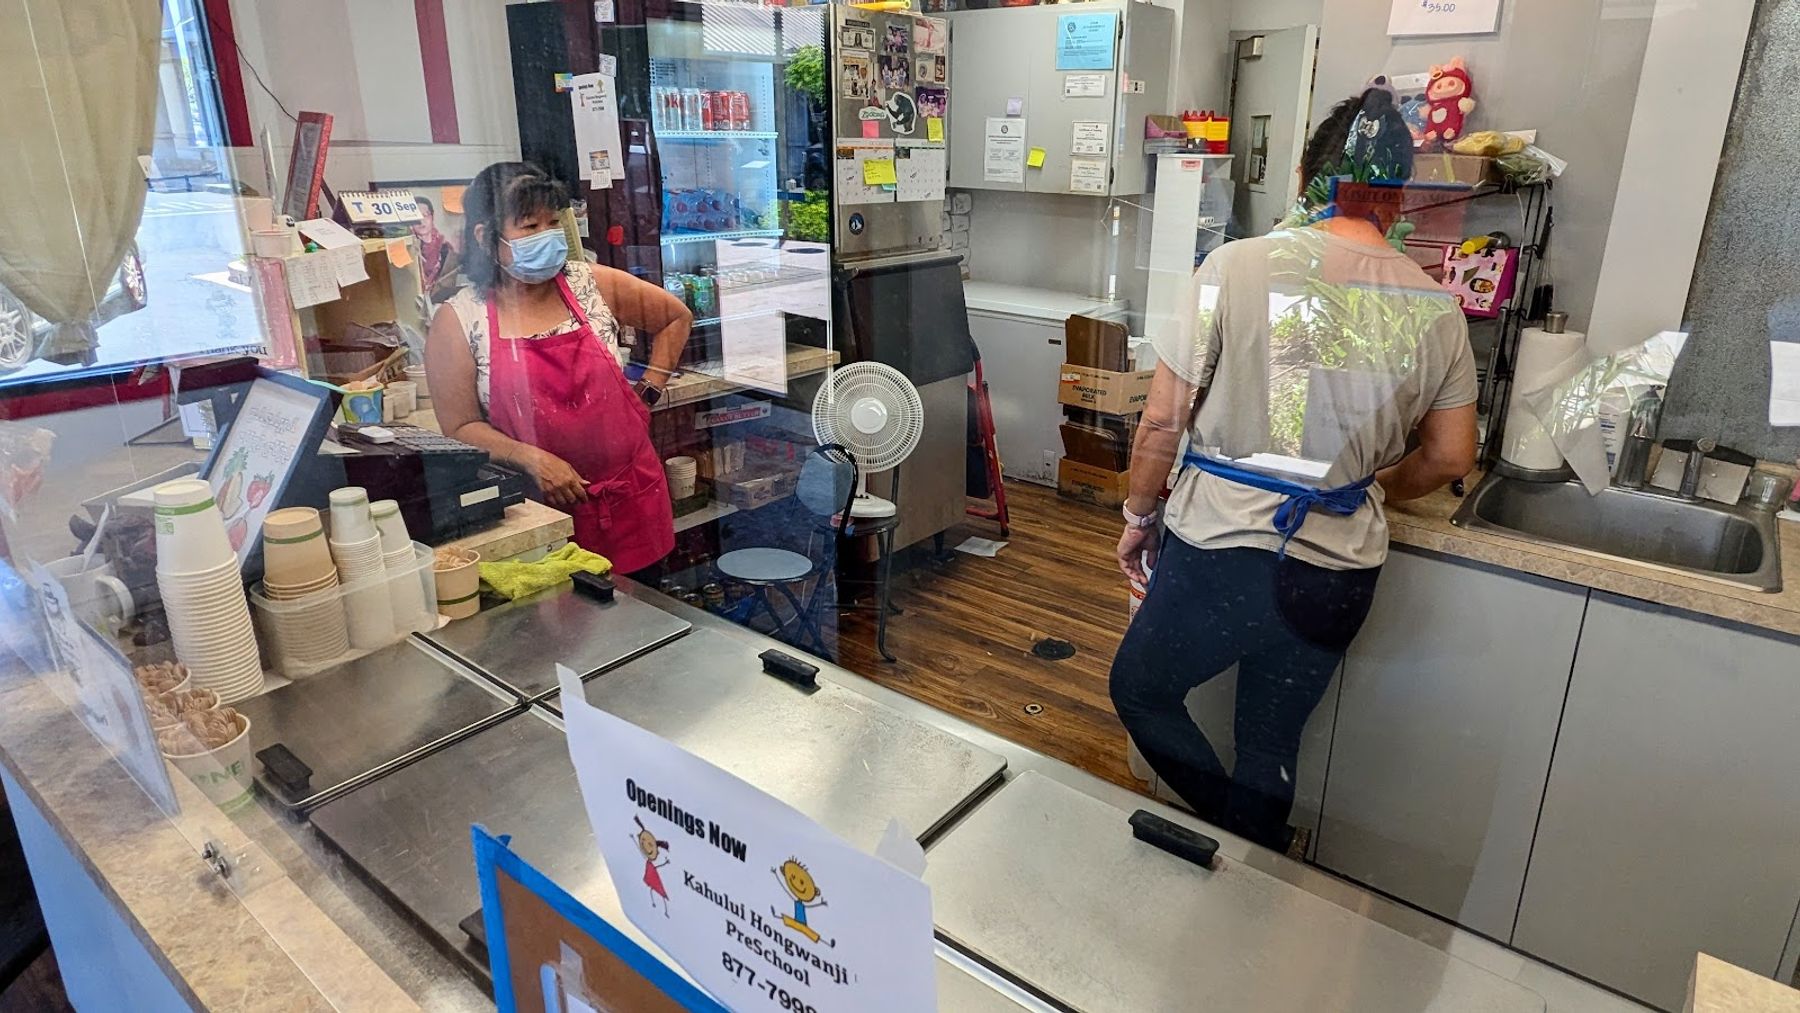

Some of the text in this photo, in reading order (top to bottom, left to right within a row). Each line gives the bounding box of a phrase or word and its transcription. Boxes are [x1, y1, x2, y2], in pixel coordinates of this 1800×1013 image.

[351, 201, 417, 215] T 30 Sep
[242, 344, 268, 356] you
[1072, 384, 1107, 396] EVAPORATED
[626, 778, 747, 863] Openings Now
[683, 870, 849, 985] Kahului Hongwanji
[725, 920, 811, 987] PreSchool
